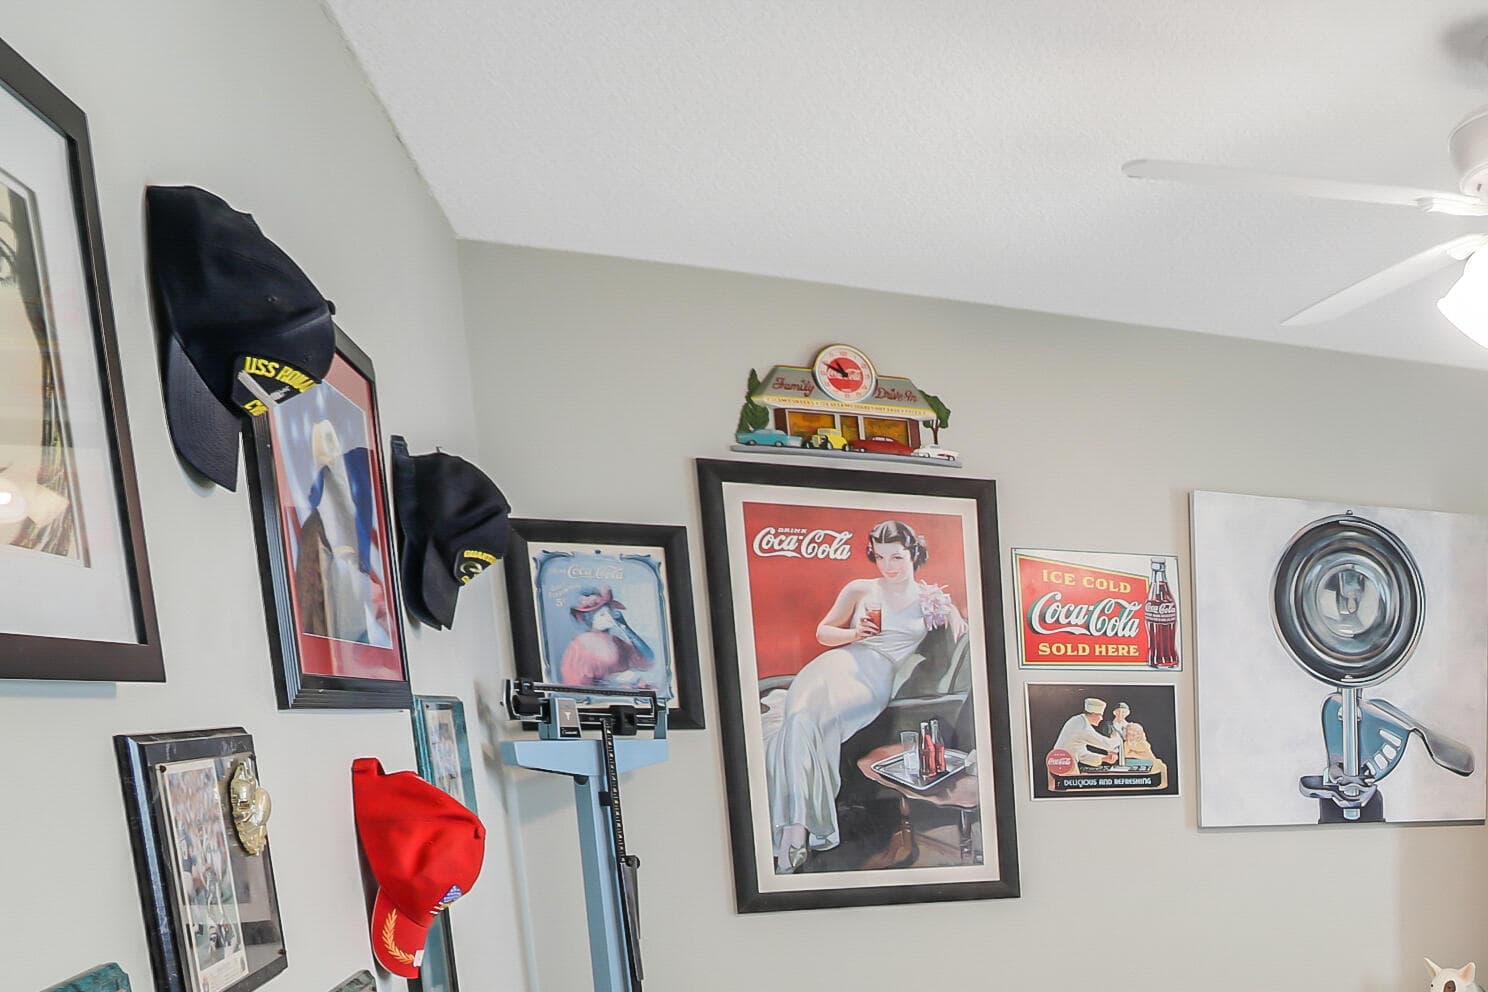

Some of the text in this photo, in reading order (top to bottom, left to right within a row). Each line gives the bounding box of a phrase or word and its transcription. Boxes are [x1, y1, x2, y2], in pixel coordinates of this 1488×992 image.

[244, 356, 280, 378] USS
[771, 376, 815, 397] Family
[753, 527, 854, 560] Coca-Cola
[1042, 569, 1132, 593] ICE COLD
[1028, 591, 1143, 638] Coca-Cola
[1038, 643, 1139, 656] SOLD HERE
[1064, 779, 1098, 787] DELICIOUS
